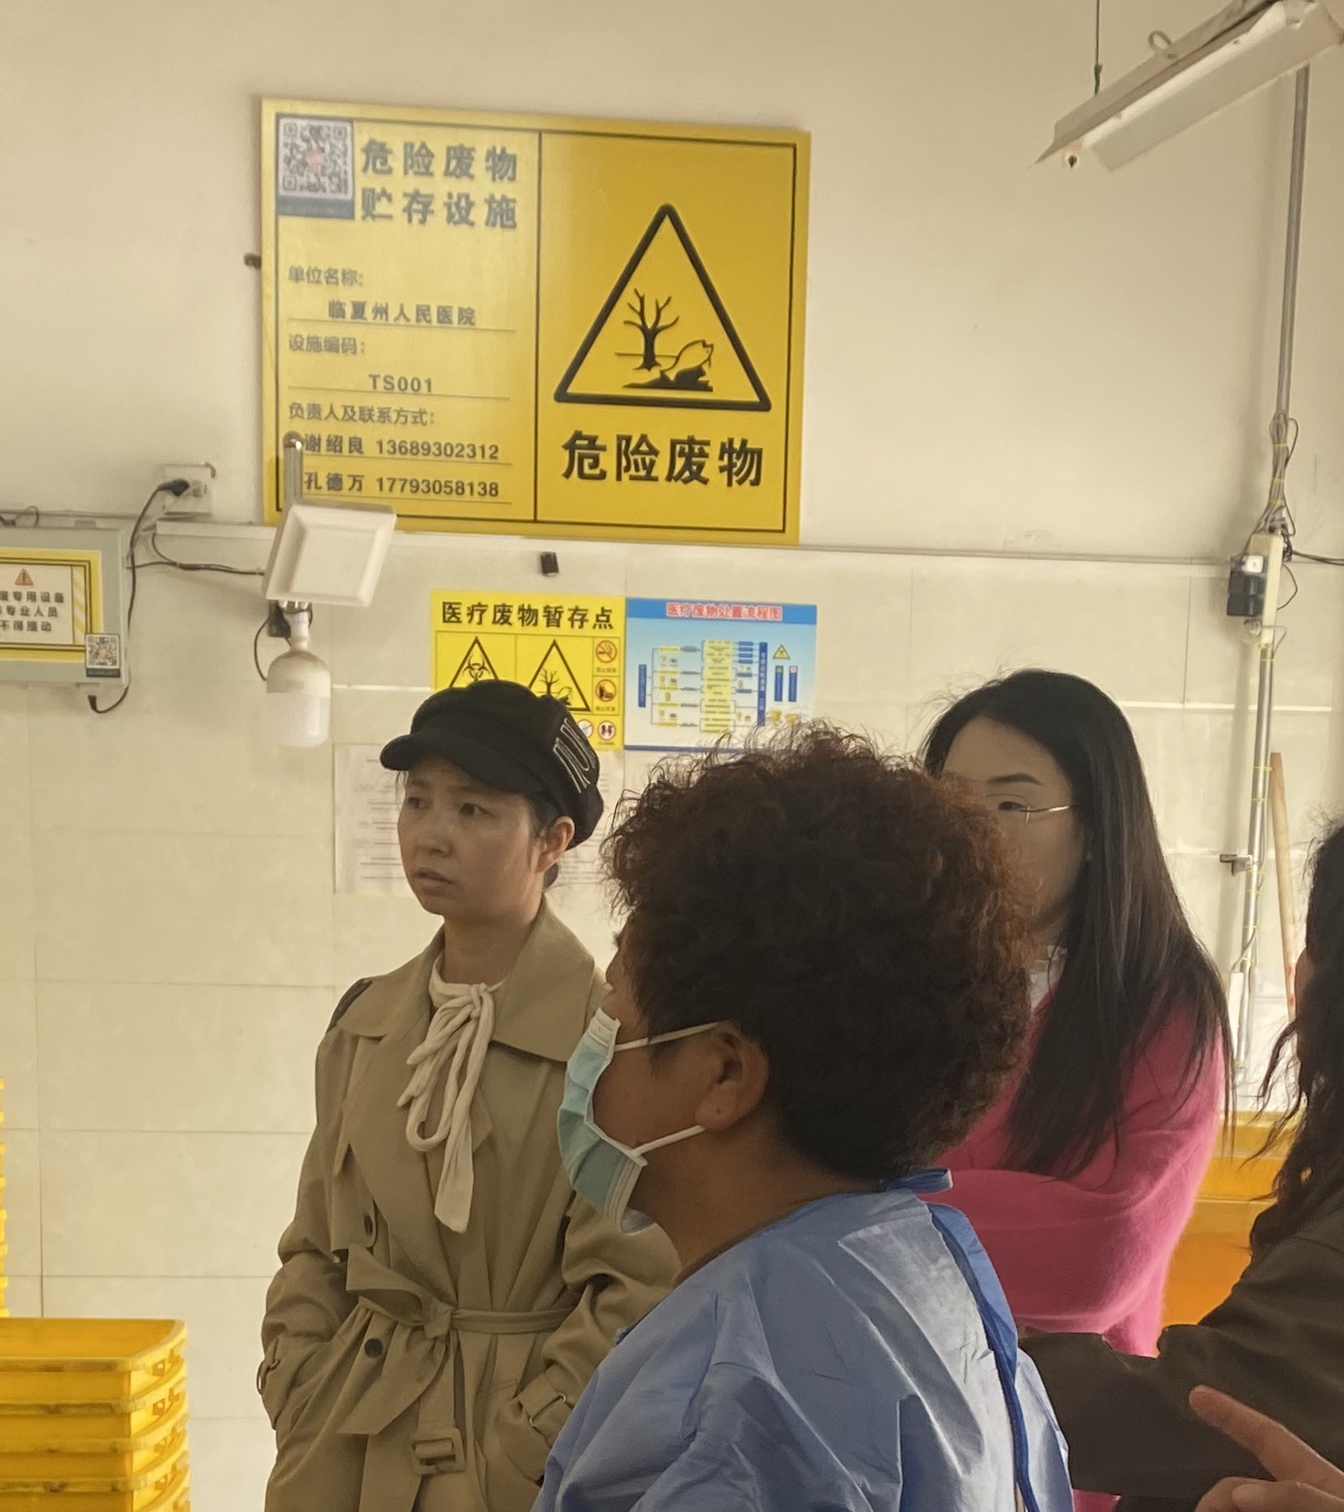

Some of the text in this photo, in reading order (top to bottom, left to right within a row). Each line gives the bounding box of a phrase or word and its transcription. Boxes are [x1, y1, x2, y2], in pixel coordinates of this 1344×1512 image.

[361, 137, 517, 182] 危险废物
[360, 187, 517, 229] 贮存设施
[328, 299, 476, 326] 临夏州人民医院
[368, 373, 434, 393] TS001
[376, 438, 499, 461] 13689302312
[561, 429, 764, 488] 危险废物
[304, 471, 499, 498] 孔德万 17793058138
[442, 601, 614, 630] 医疗废物暂存点
